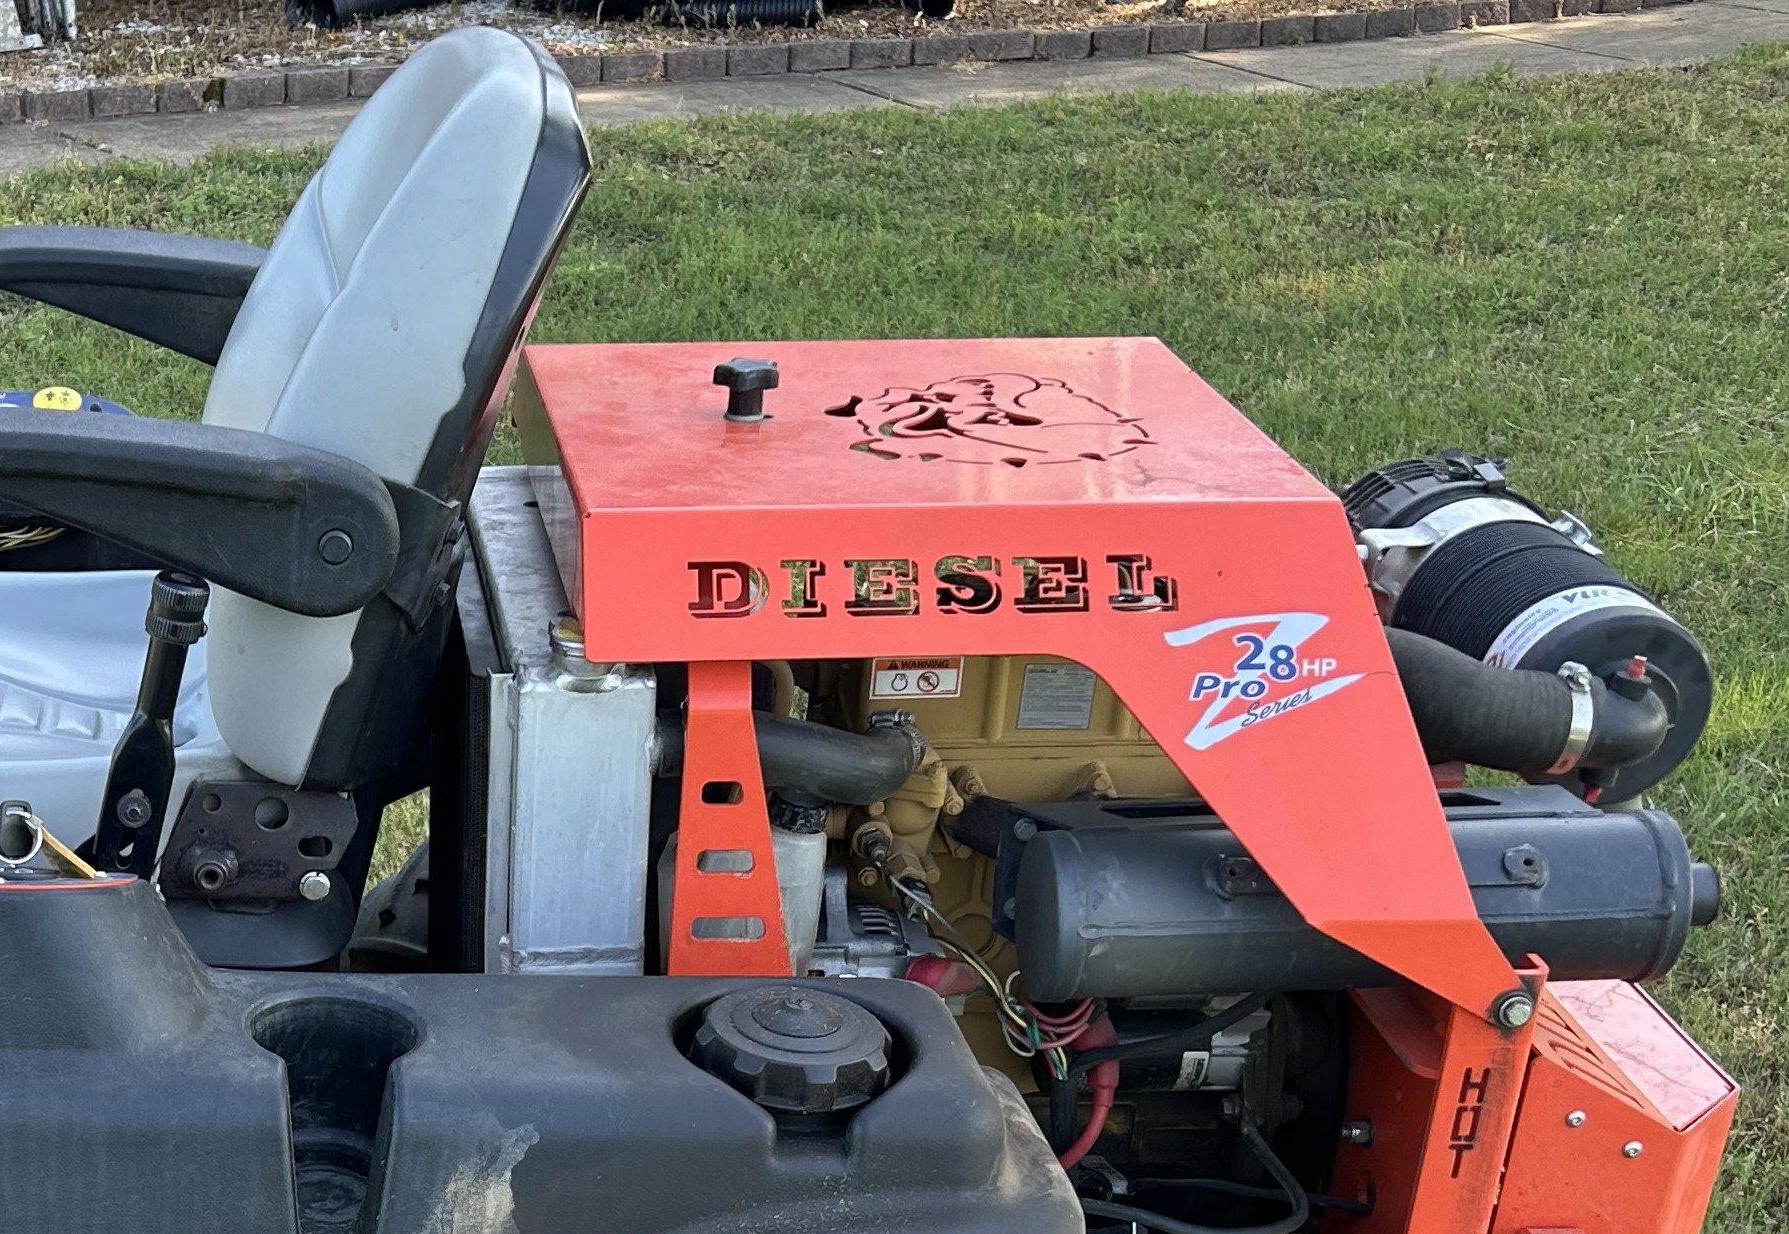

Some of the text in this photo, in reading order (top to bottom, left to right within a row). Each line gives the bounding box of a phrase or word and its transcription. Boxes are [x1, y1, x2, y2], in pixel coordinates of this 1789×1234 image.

[686, 554, 1180, 619] DIESEL
[900, 659, 950, 670] WARNING
[1233, 634, 1338, 682] 28 HP
[1190, 674, 1268, 700] Pro
[1241, 687, 1313, 728] Series
[1447, 1066, 1492, 1180] HOT
